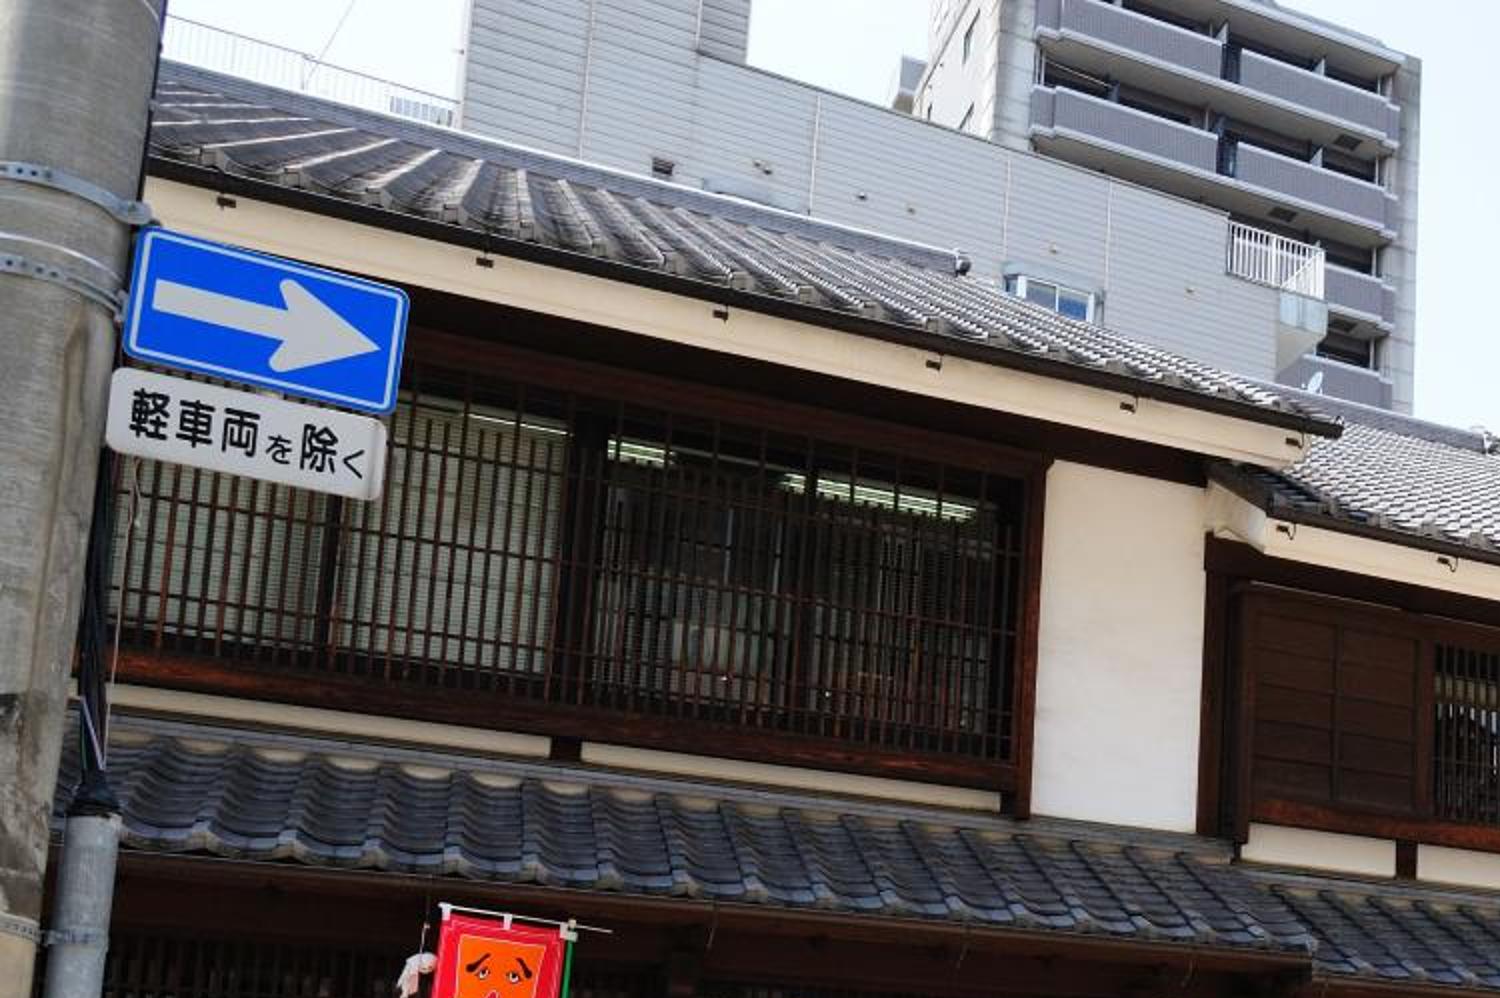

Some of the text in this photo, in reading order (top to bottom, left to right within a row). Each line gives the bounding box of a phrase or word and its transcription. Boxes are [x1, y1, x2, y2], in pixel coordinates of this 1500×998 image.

[129, 387, 366, 479] 軽車両を除く
